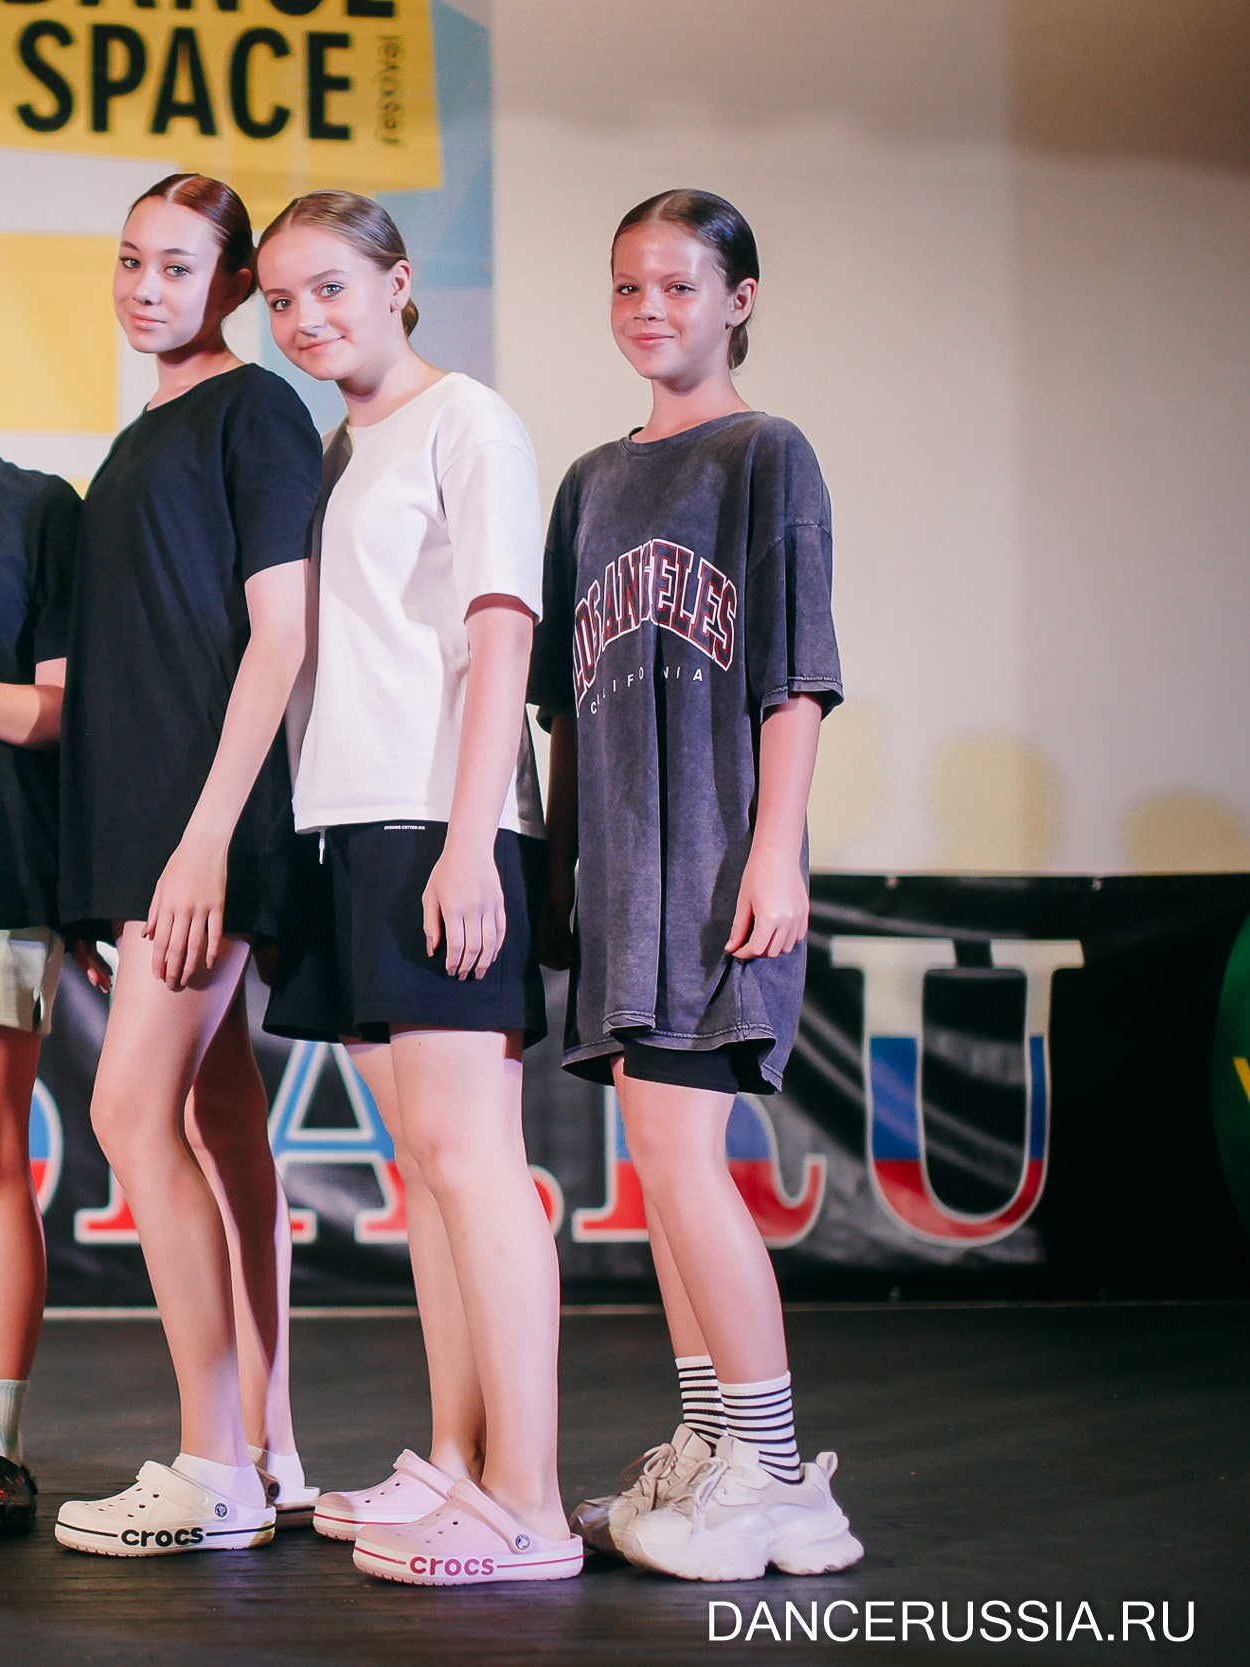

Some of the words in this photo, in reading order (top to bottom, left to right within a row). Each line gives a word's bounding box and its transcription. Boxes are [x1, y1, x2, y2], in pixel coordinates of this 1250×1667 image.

[15, 18, 352, 141] SPACE
[120, 1527, 203, 1547] crocs
[410, 1556, 494, 1577] crocs
